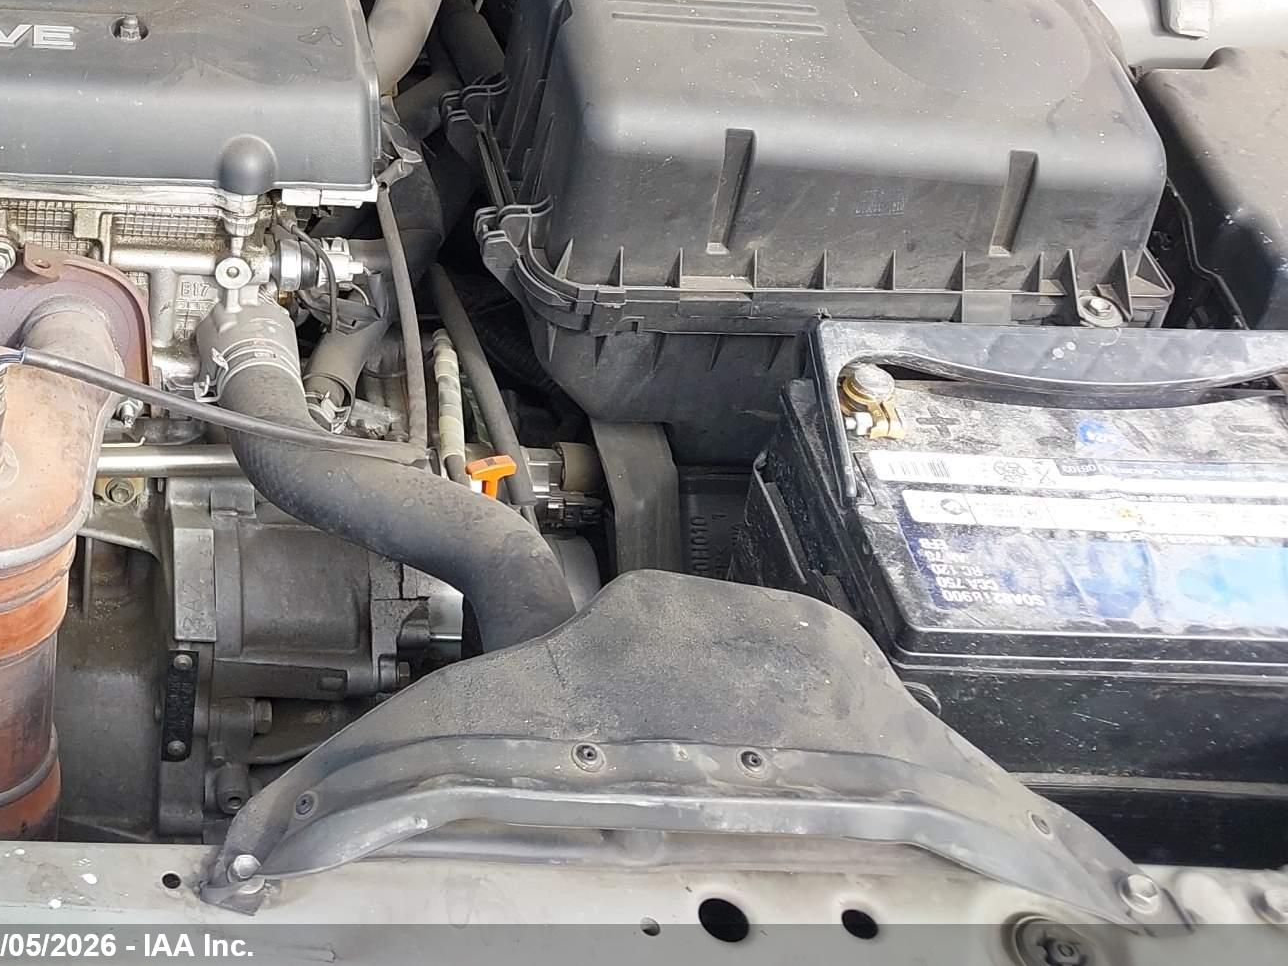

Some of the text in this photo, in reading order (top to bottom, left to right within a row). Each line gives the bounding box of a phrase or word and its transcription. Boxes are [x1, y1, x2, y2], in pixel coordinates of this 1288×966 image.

[181, 281, 211, 297] B17
[931, 563, 984, 577] RC 120
[934, 576, 1000, 591] CCA 750
